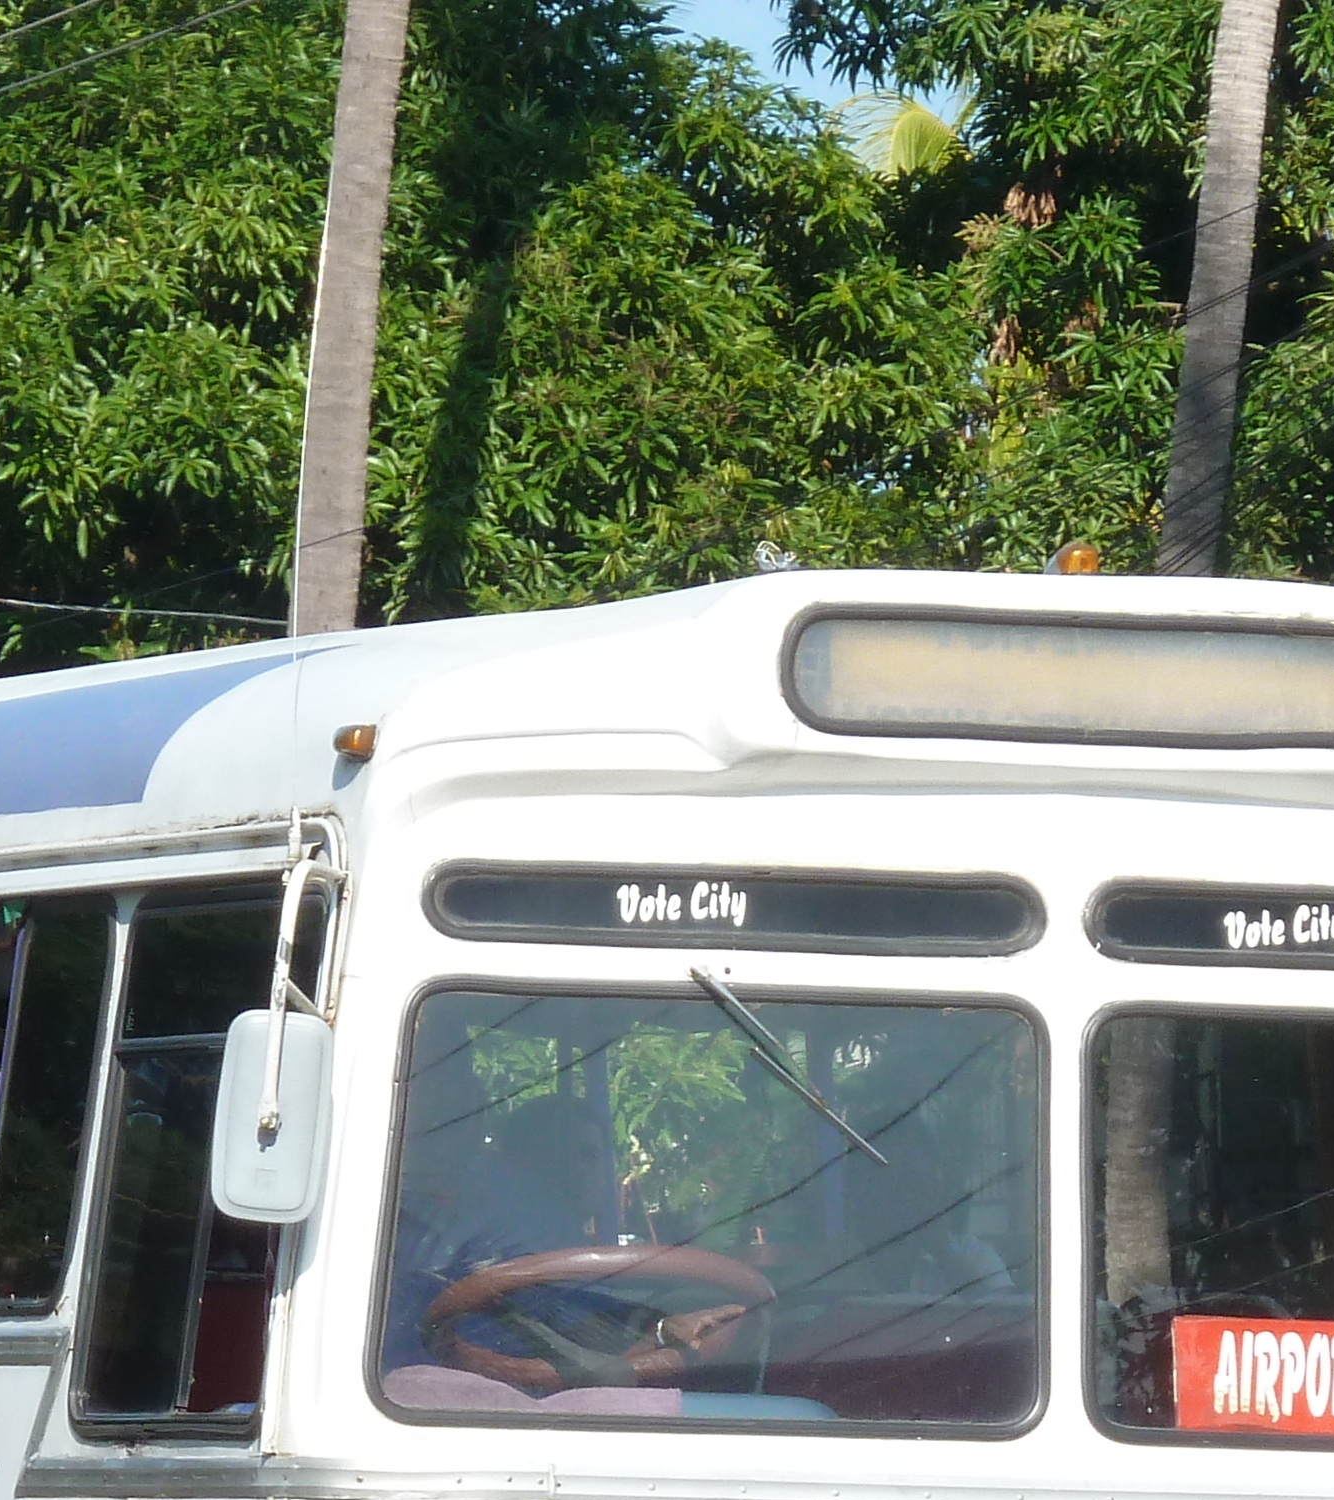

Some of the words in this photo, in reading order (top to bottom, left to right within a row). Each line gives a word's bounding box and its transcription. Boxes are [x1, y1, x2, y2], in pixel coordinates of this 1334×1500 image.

[617, 883, 681, 923] Vote
[691, 881, 747, 927] City
[1223, 909, 1286, 949] Vote
